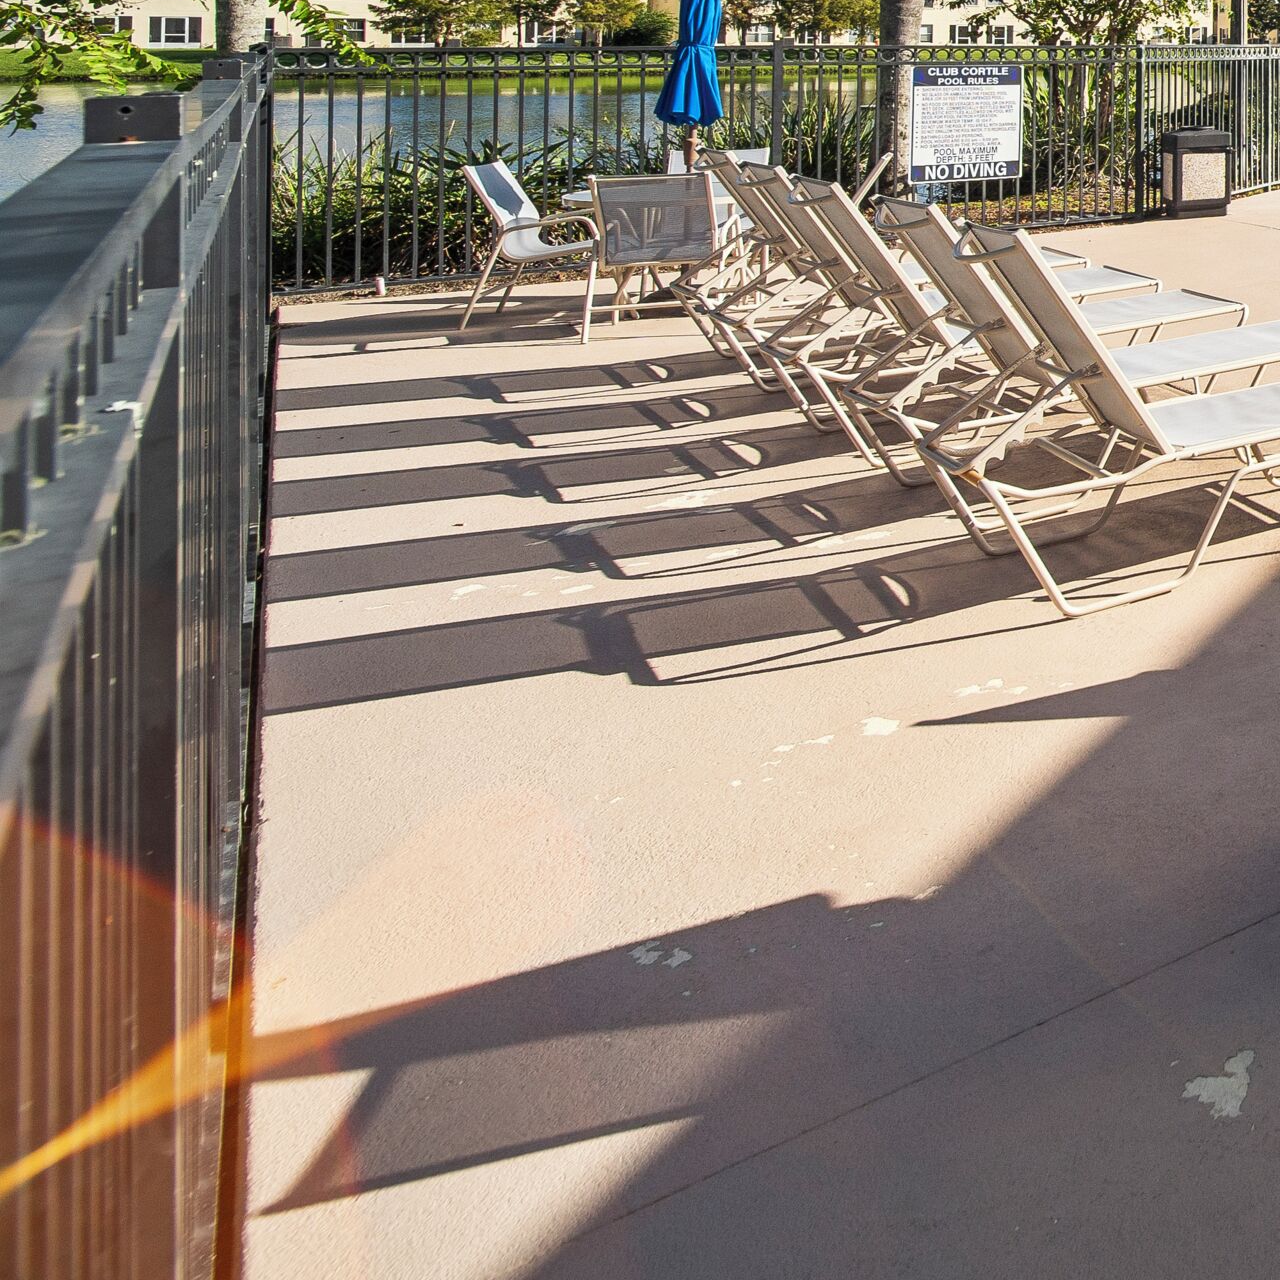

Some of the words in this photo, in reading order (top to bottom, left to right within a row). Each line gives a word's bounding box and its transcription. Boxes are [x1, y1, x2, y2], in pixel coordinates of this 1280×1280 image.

[928, 67, 958, 76] CLUB
[961, 67, 1008, 76] CORTILE
[968, 77, 999, 85] RULES
[934, 148, 956, 156] POOL
[959, 146, 998, 155] MAXIMUM
[925, 165, 949, 180] NO
[953, 162, 1007, 178] DIVING
